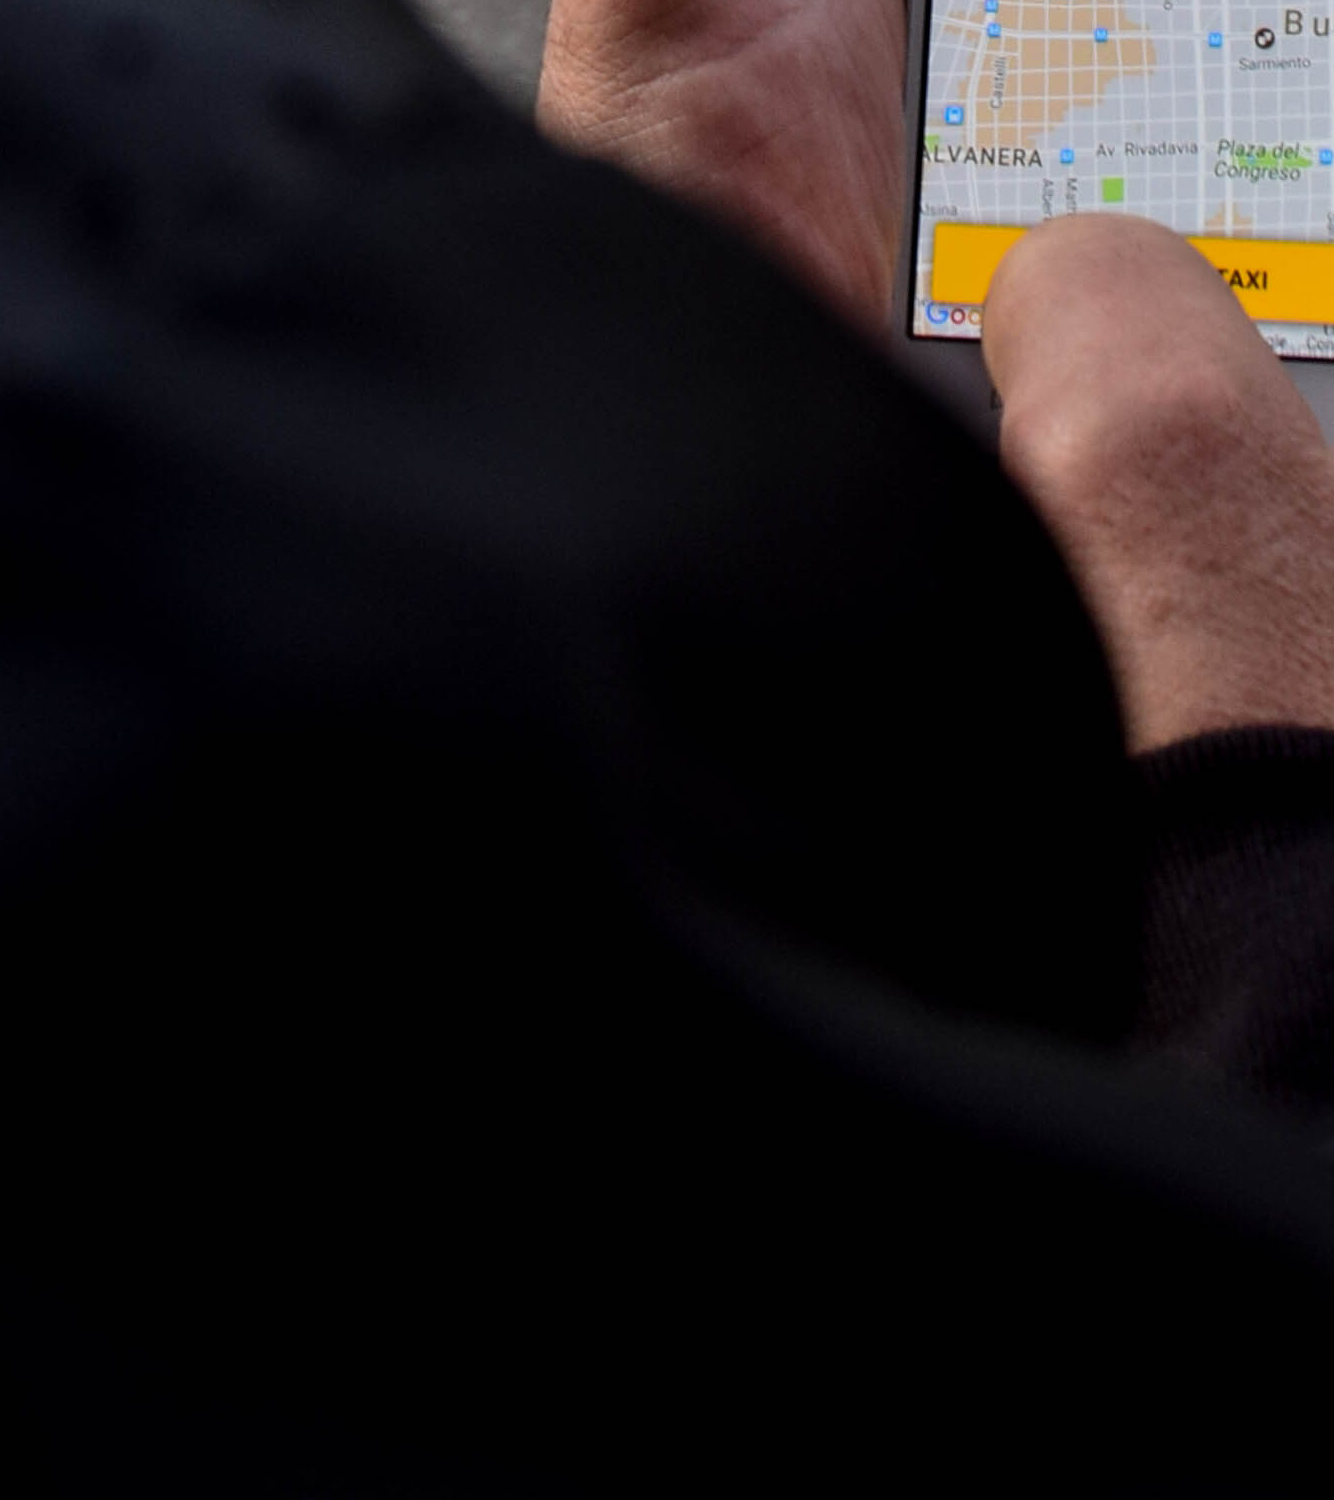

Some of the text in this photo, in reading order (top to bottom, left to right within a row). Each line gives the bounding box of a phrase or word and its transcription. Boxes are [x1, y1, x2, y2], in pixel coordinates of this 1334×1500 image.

[1239, 57, 1311, 71] Sarmiento
[1124, 140, 1198, 156] Rivadavia
[1217, 139, 1300, 159] Plaza del
[1214, 160, 1301, 182] Congreso
